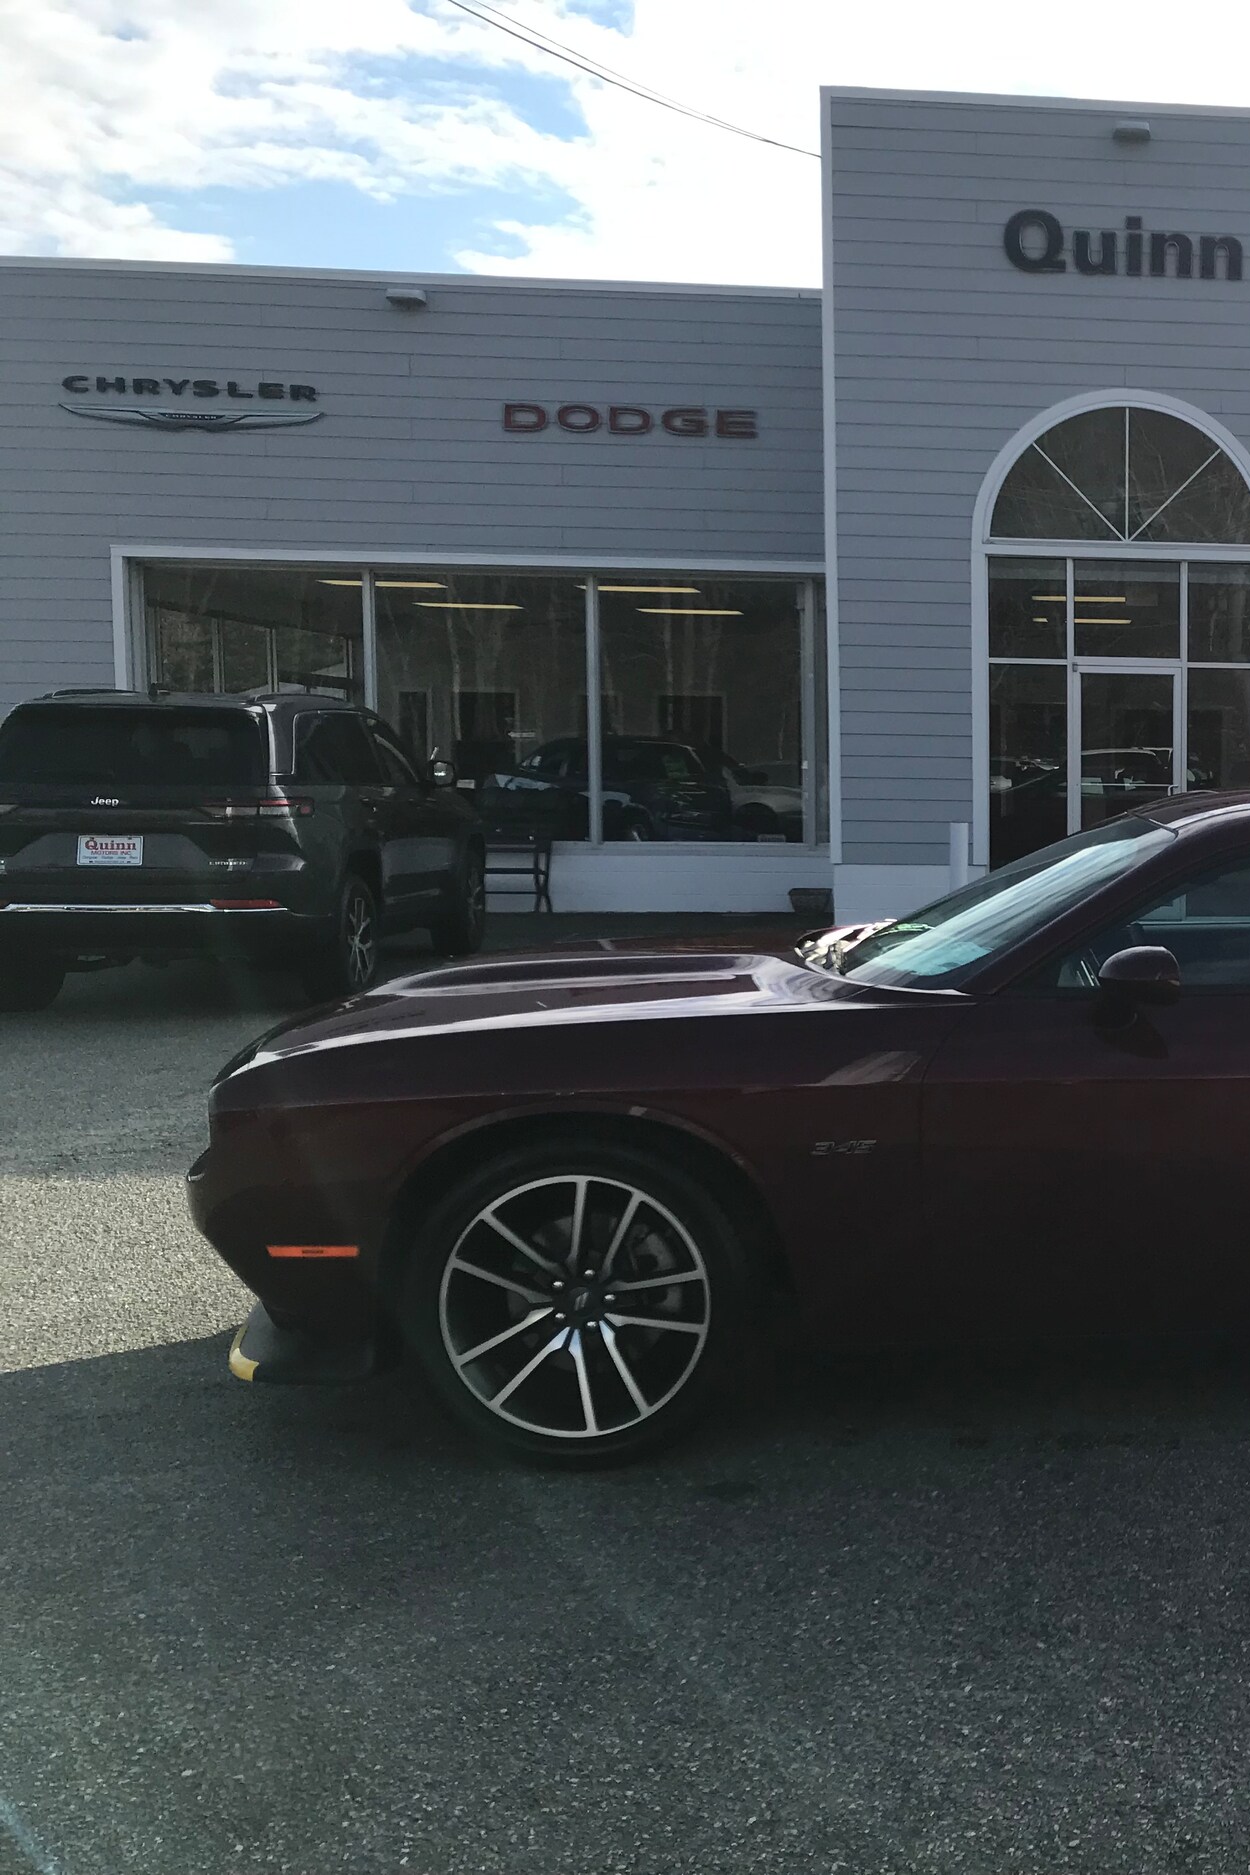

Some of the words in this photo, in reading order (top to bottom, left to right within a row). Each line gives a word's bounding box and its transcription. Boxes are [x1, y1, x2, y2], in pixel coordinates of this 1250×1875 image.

[1003, 208, 1243, 281] Quinn
[61, 375, 318, 401] CHRYSLER
[503, 403, 758, 439] DODGE
[90, 796, 119, 807] Jeep
[85, 839, 136, 850] Quinn
